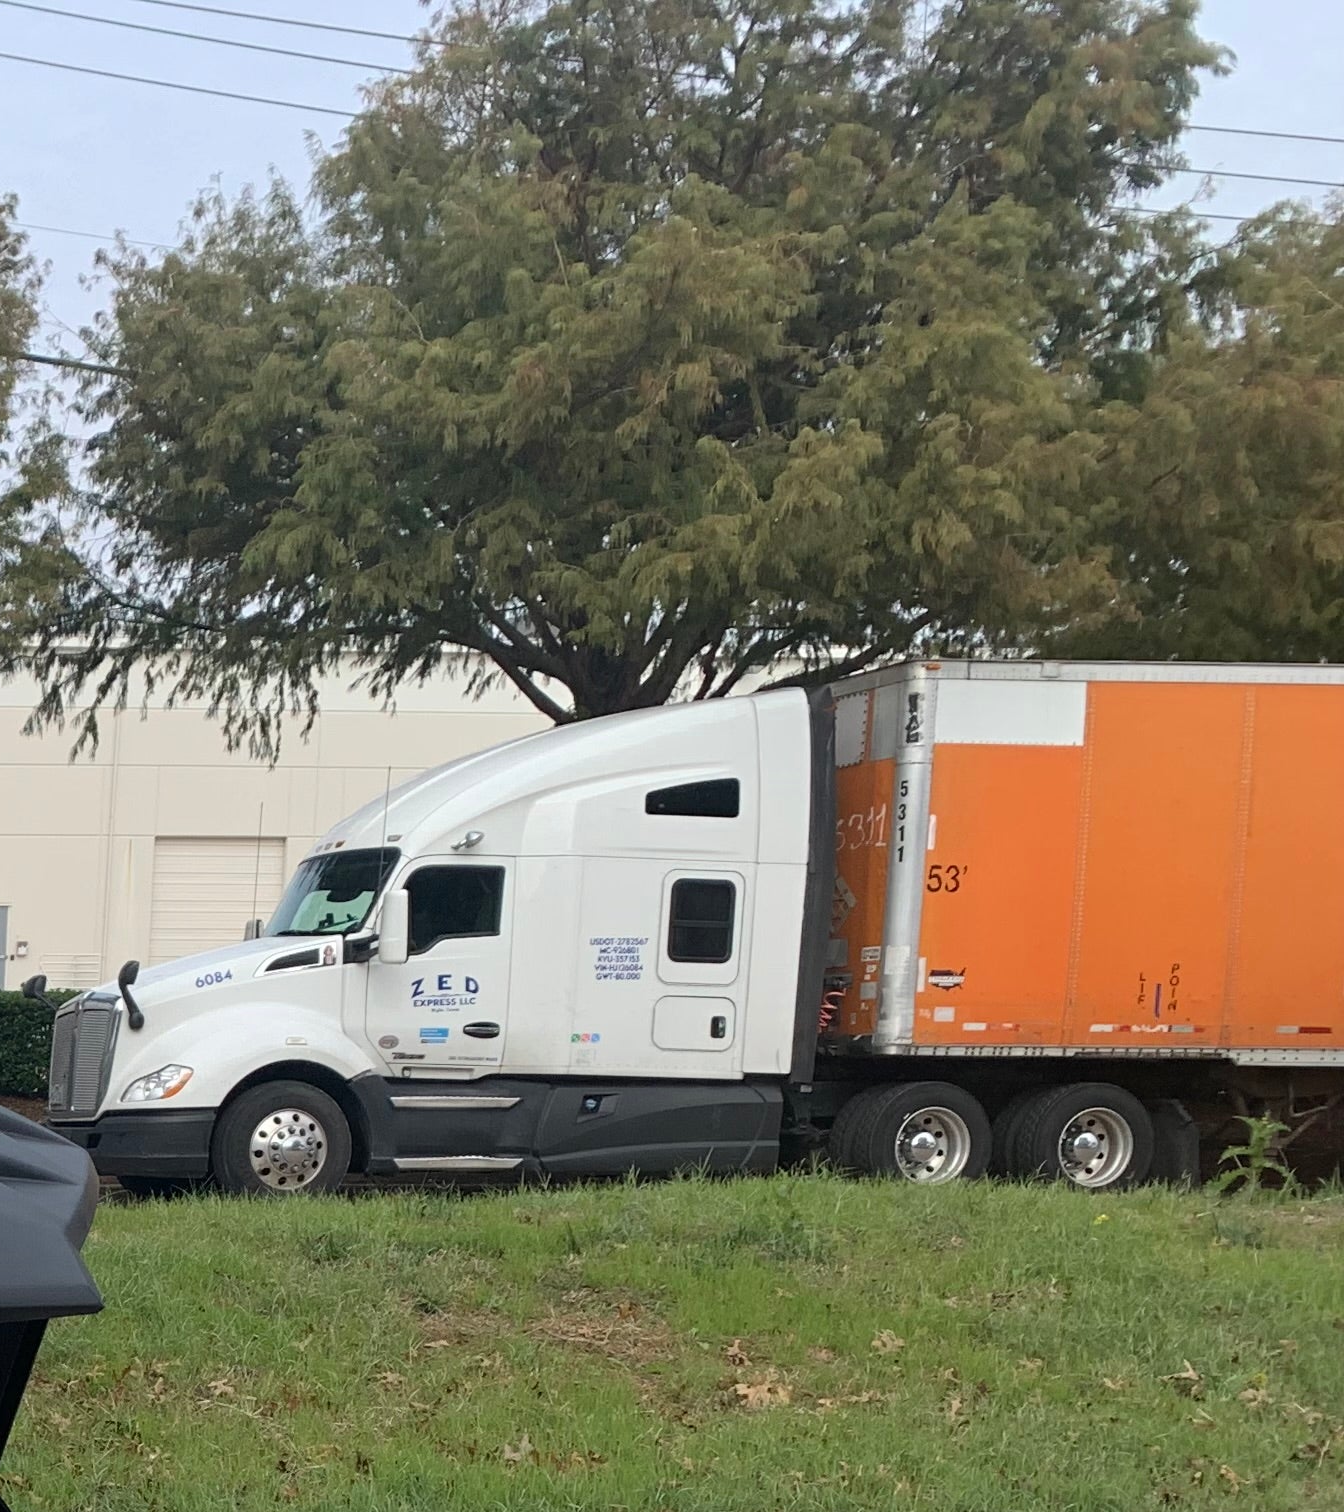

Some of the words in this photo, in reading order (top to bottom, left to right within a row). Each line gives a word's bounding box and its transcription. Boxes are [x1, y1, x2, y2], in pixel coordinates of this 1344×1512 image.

[195, 967, 234, 988] 6084
[413, 998, 457, 1008] EXPRESS
[459, 997, 477, 1006] LLC
